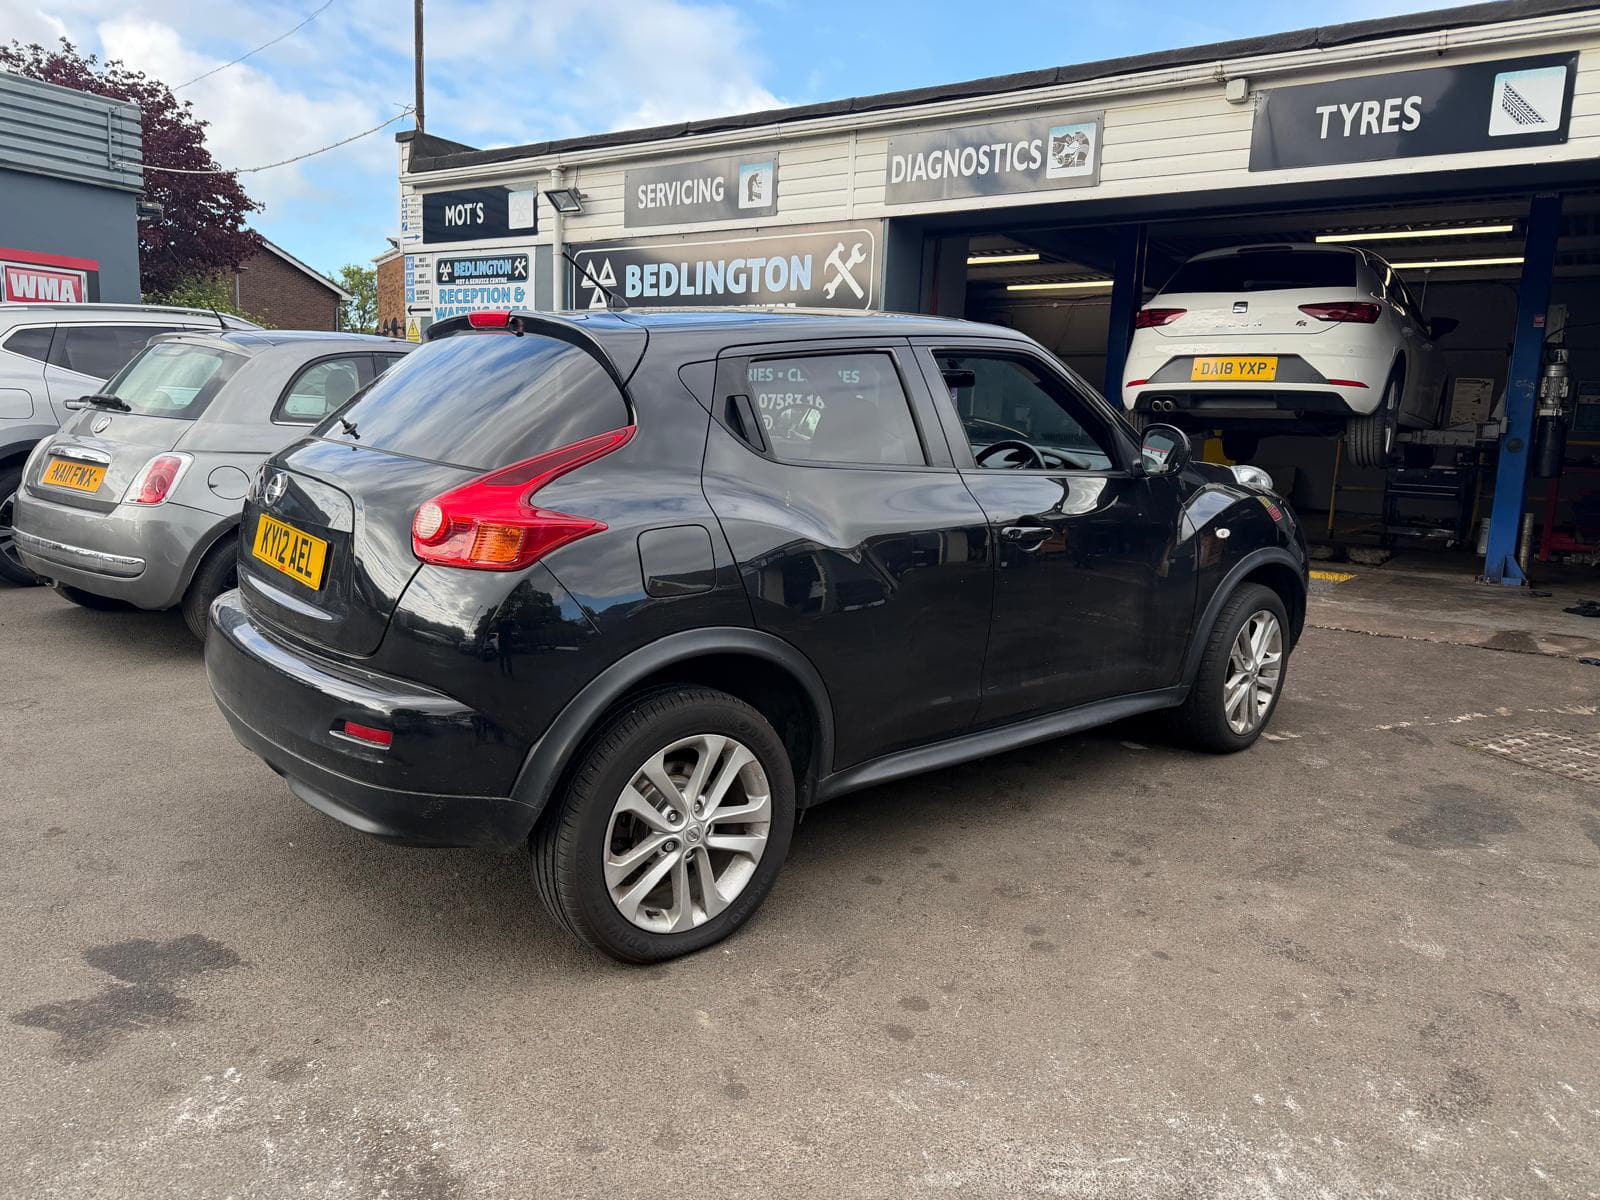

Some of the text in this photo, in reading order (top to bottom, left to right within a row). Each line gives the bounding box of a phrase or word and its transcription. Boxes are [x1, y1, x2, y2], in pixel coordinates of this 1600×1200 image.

[1316, 95, 1422, 139] TYRES
[890, 138, 1043, 185] DIAGNOSTICS
[637, 176, 725, 210] SERVICING
[445, 203, 484, 226] MOT'S
[453, 260, 512, 276] BEDLINGTON
[625, 254, 812, 297] BEDLINGTON
[9, 272, 76, 302] WMA
[439, 286, 526, 304] RECEPTION &
[1201, 361, 1268, 375] DA18 YXP
[260, 521, 313, 579] KY12 AEL
